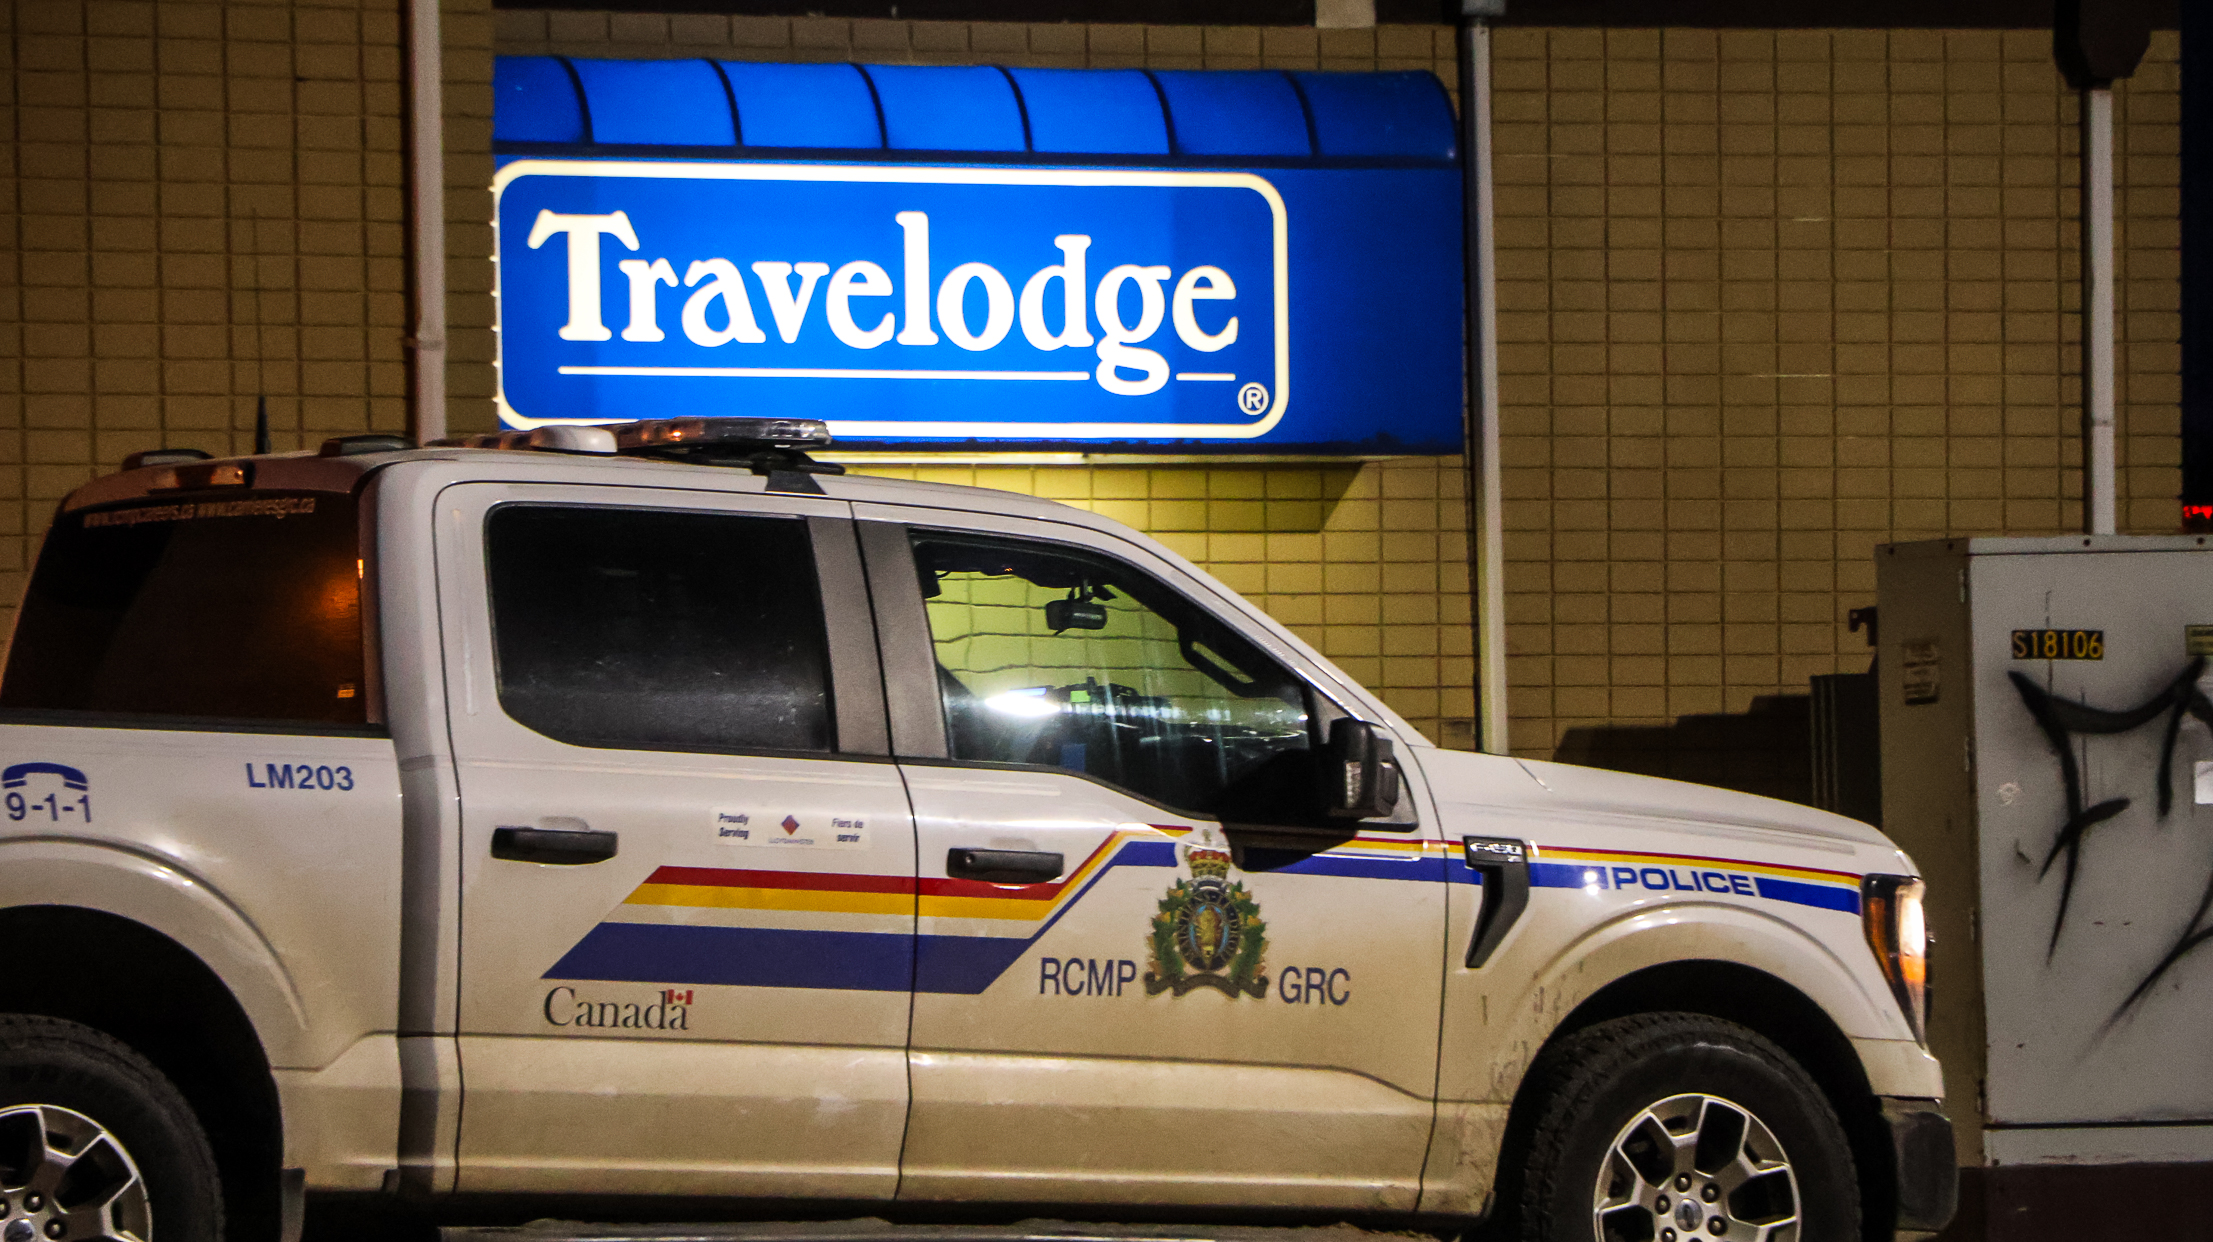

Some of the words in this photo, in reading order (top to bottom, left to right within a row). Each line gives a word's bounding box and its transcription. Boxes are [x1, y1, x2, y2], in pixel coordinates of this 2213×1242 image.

[528, 209, 1239, 396] Travelodge
[2013, 631, 2103, 658] S18106
[246, 762, 354, 791] LM203
[6, 792, 91, 823] 9-1-1
[718, 813, 749, 826] Proudly
[718, 827, 749, 840] Serving
[831, 818, 852, 829] Fiers
[854, 819, 864, 829] de
[837, 832, 860, 843] servir
[1611, 866, 1755, 897] POLICE
[1039, 957, 1137, 997] RCMP
[1278, 966, 1351, 1006] GRC
[543, 985, 689, 1031] Canada
